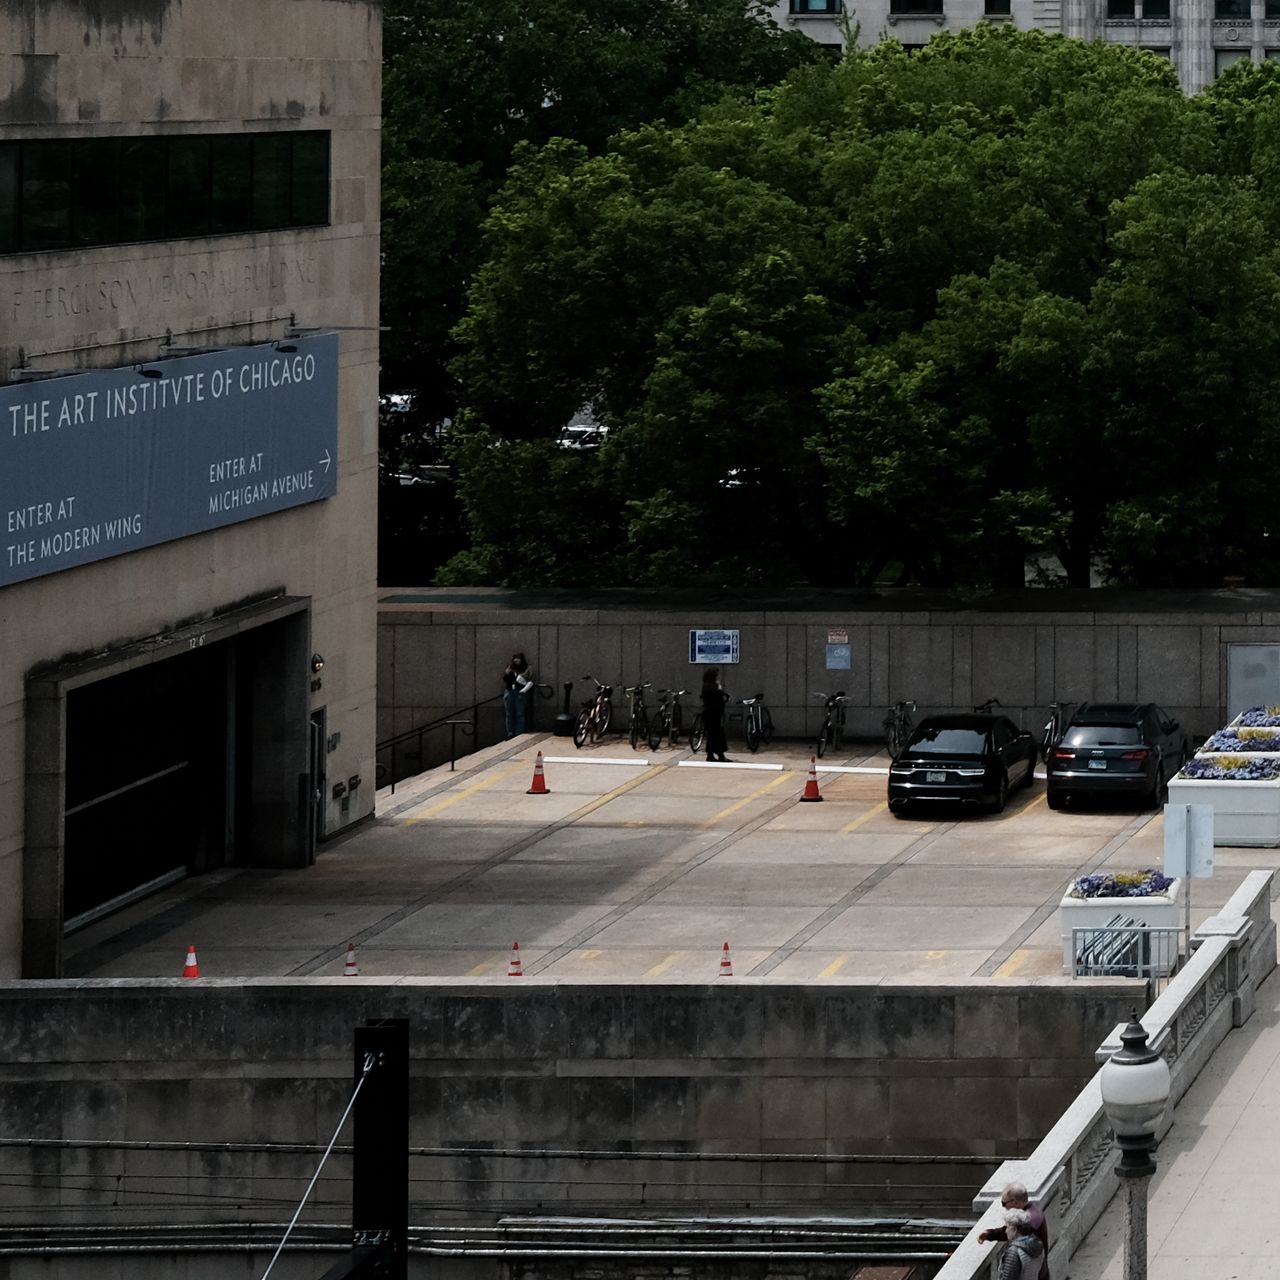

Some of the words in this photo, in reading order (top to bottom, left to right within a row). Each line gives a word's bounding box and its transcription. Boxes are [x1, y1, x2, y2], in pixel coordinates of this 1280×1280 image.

[9, 400, 50, 436] THE
[58, 392, 98, 428] ART
[106, 373, 205, 419] INSTITVTE
[211, 369, 234, 399] OF
[240, 353, 316, 393] CHICAGO
[209, 459, 246, 483] ENTER
[249, 453, 264, 473] AT
[8, 505, 53, 532] ENTER
[58, 497, 76, 519] AT
[208, 482, 268, 515] MICHIGAN
[271, 470, 314, 498] AVENUE
[7, 545, 35, 567] THE
[40, 525, 100, 560] MODERN
[104, 514, 142, 540] WING
